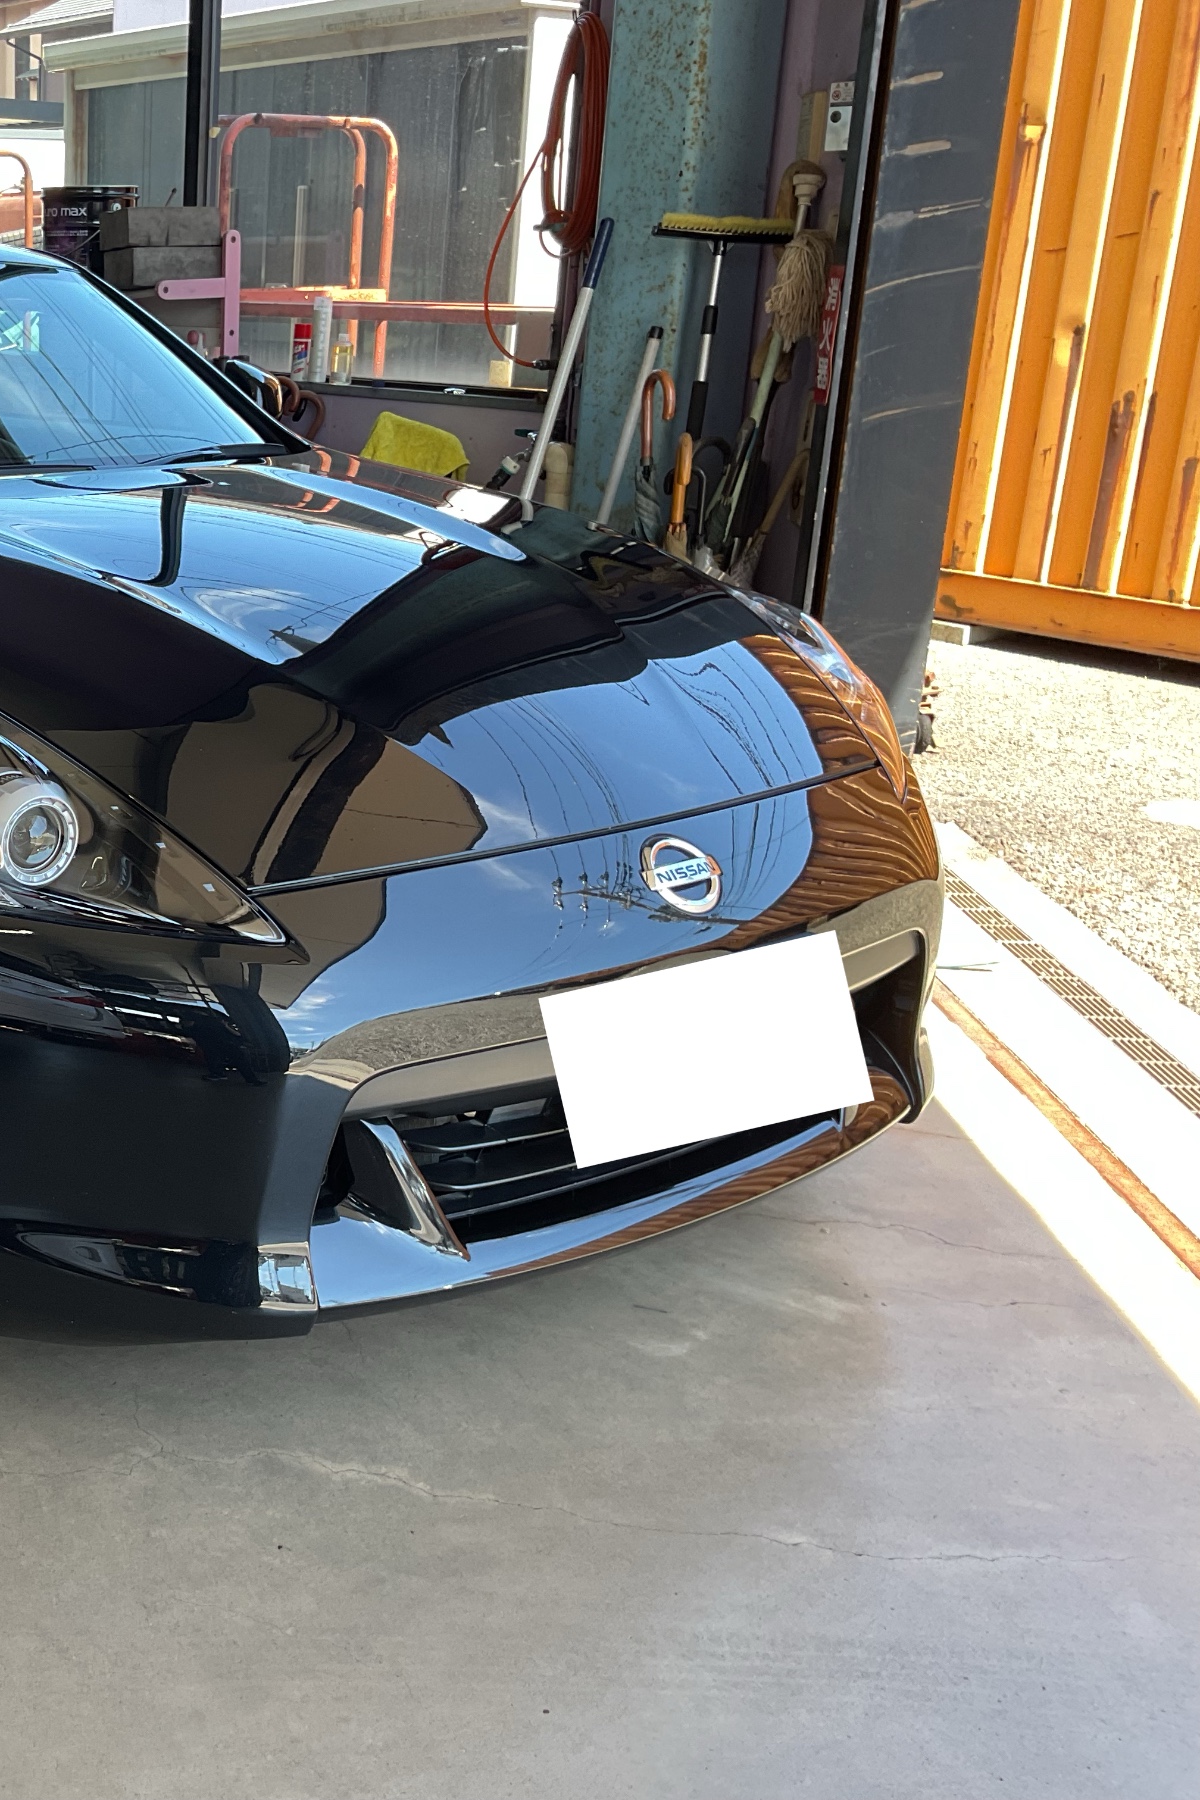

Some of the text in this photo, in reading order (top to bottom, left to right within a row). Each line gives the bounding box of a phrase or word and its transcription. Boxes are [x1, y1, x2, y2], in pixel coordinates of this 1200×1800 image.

[60, 207, 88, 217] max
[816, 278, 841, 390] 消火器
[655, 861, 717, 883] NISSAN
